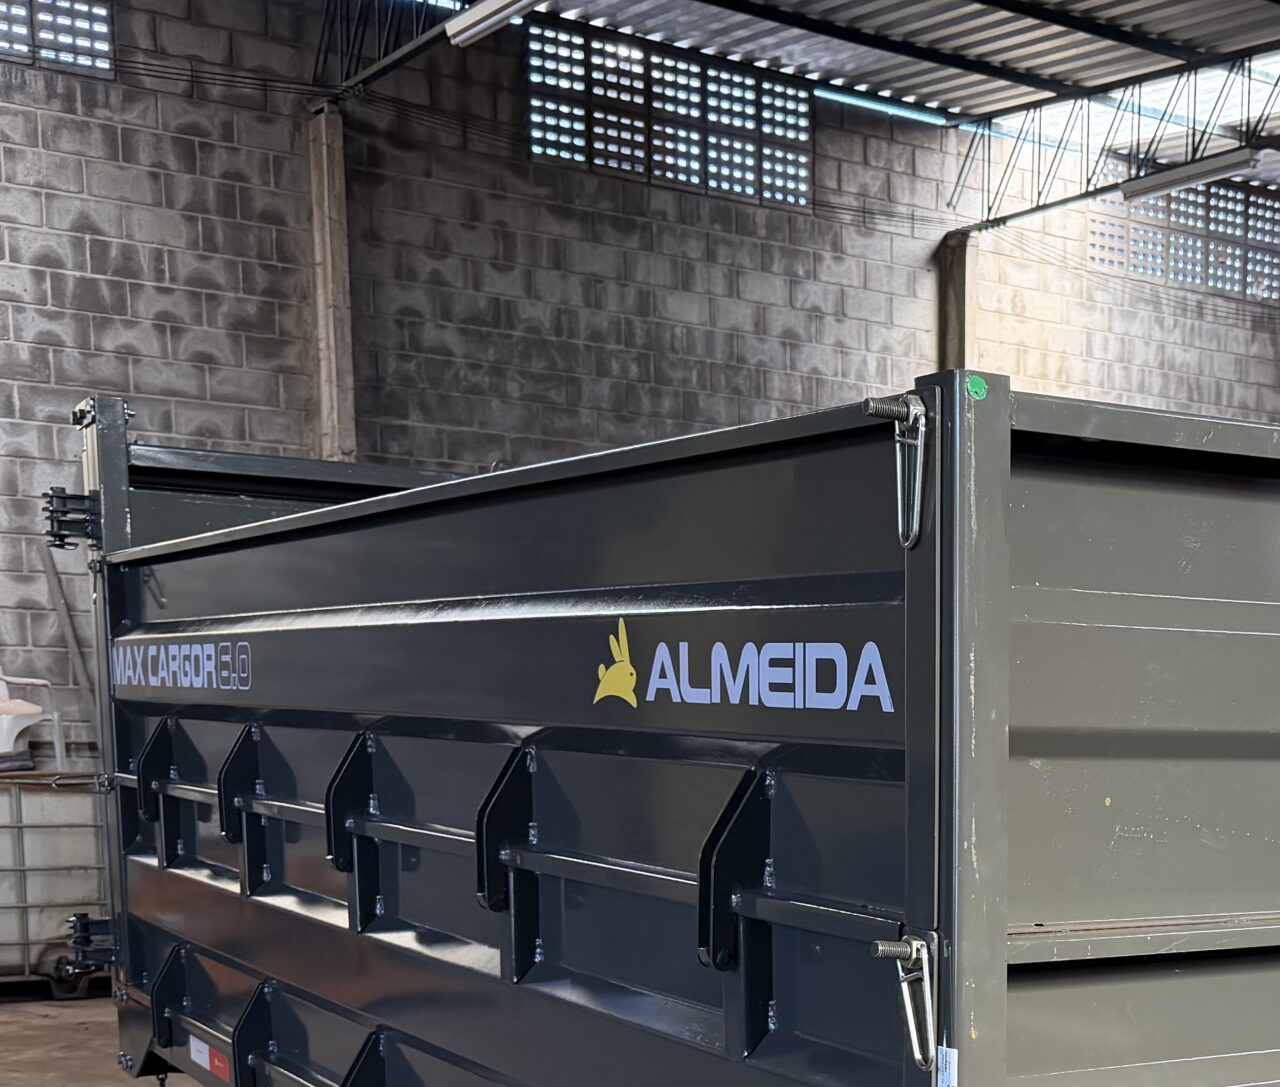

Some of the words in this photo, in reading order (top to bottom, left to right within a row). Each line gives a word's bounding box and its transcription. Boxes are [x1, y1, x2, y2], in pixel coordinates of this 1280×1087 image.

[112, 645, 145, 686] MAX
[147, 643, 217, 689] CARGOR
[218, 641, 251, 690] 6.0
[645, 641, 895, 712] ALMEIDA
